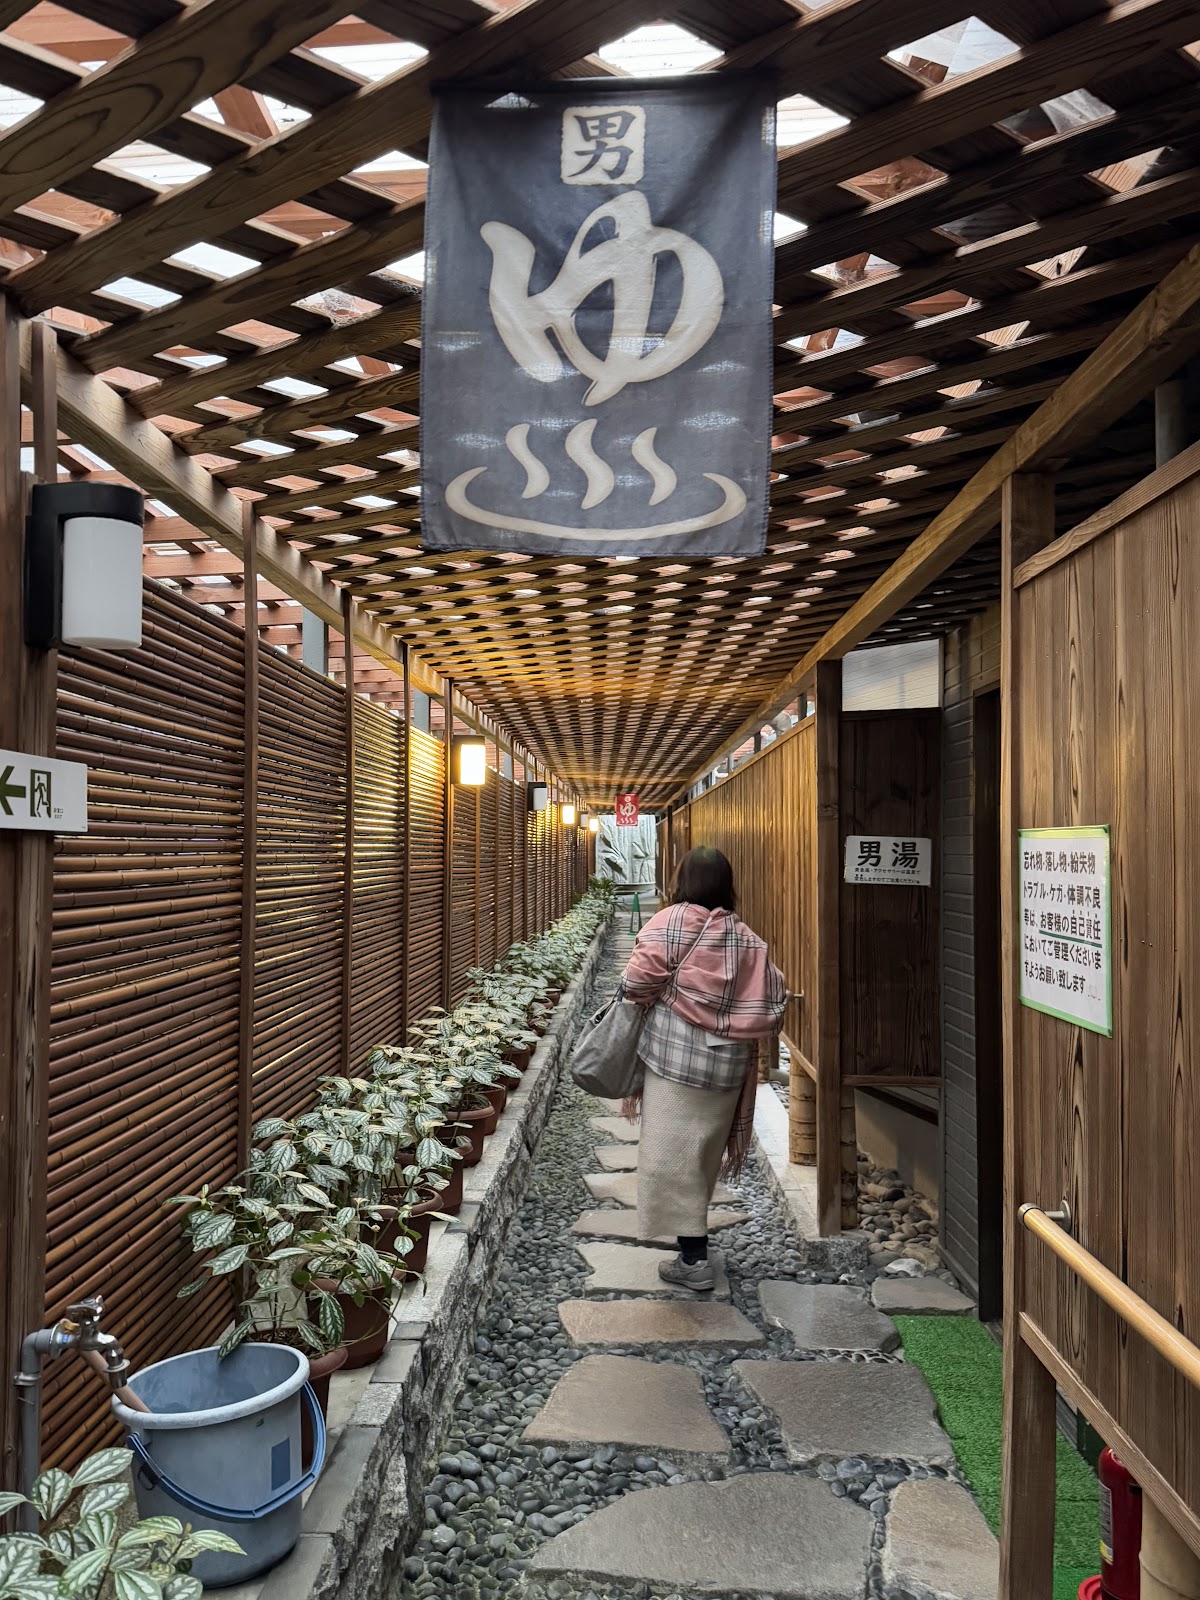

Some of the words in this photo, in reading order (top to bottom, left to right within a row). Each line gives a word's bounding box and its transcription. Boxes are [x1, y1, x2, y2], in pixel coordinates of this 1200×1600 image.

[567, 111, 637, 180] 男
[480, 190, 725, 407] ゆ
[619, 802, 637, 816] ゆ
[858, 841, 920, 869] 男湯
